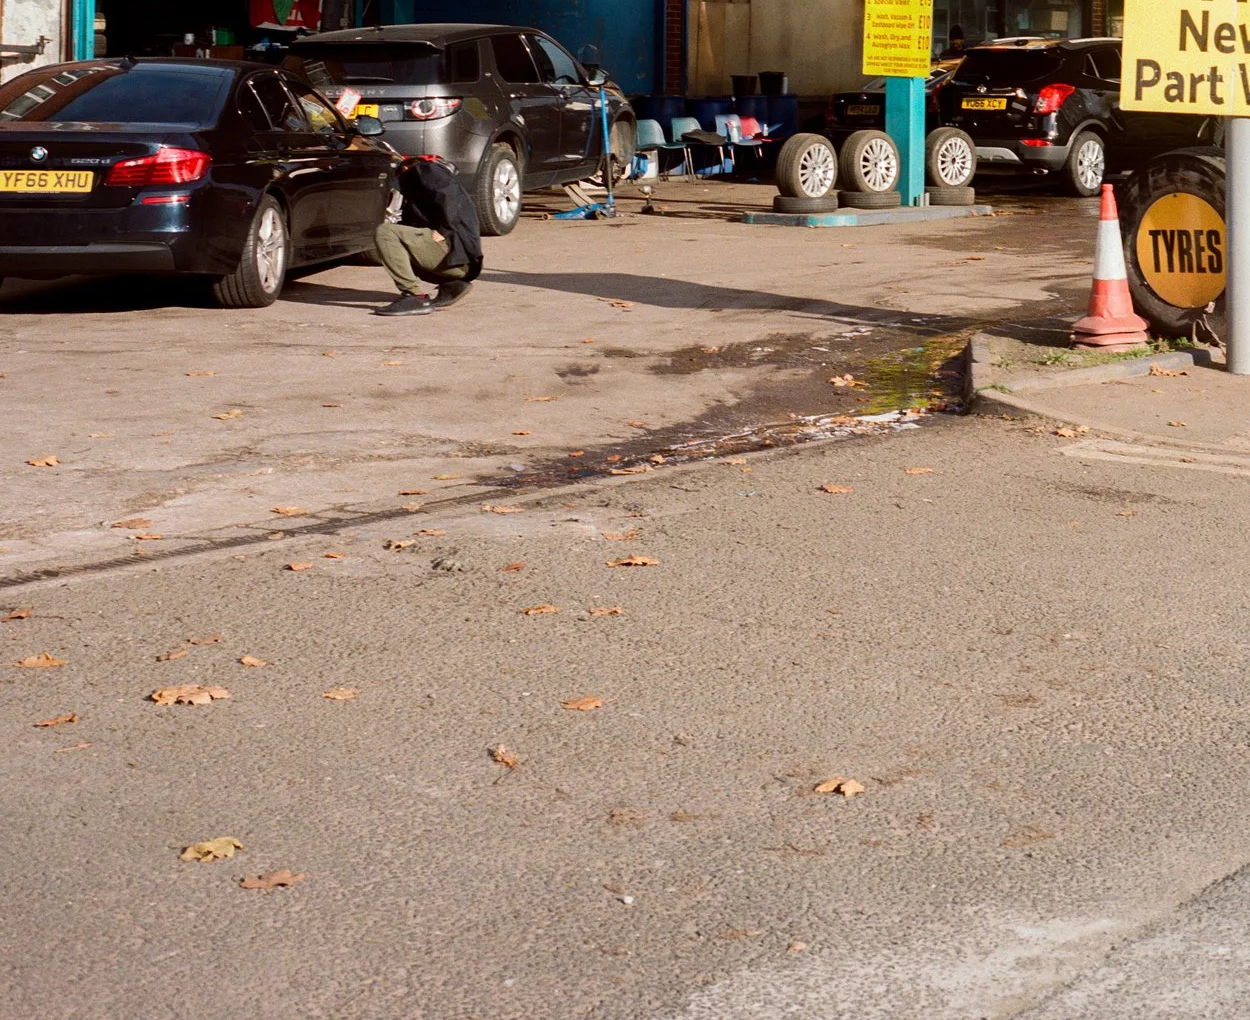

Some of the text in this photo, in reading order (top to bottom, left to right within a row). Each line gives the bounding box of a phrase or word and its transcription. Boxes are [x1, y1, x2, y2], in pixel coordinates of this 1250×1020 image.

[1134, 58, 1225, 105] Part
[3, 172, 89, 188] YF66 XHU
[1148, 229, 1223, 274] TYRES
